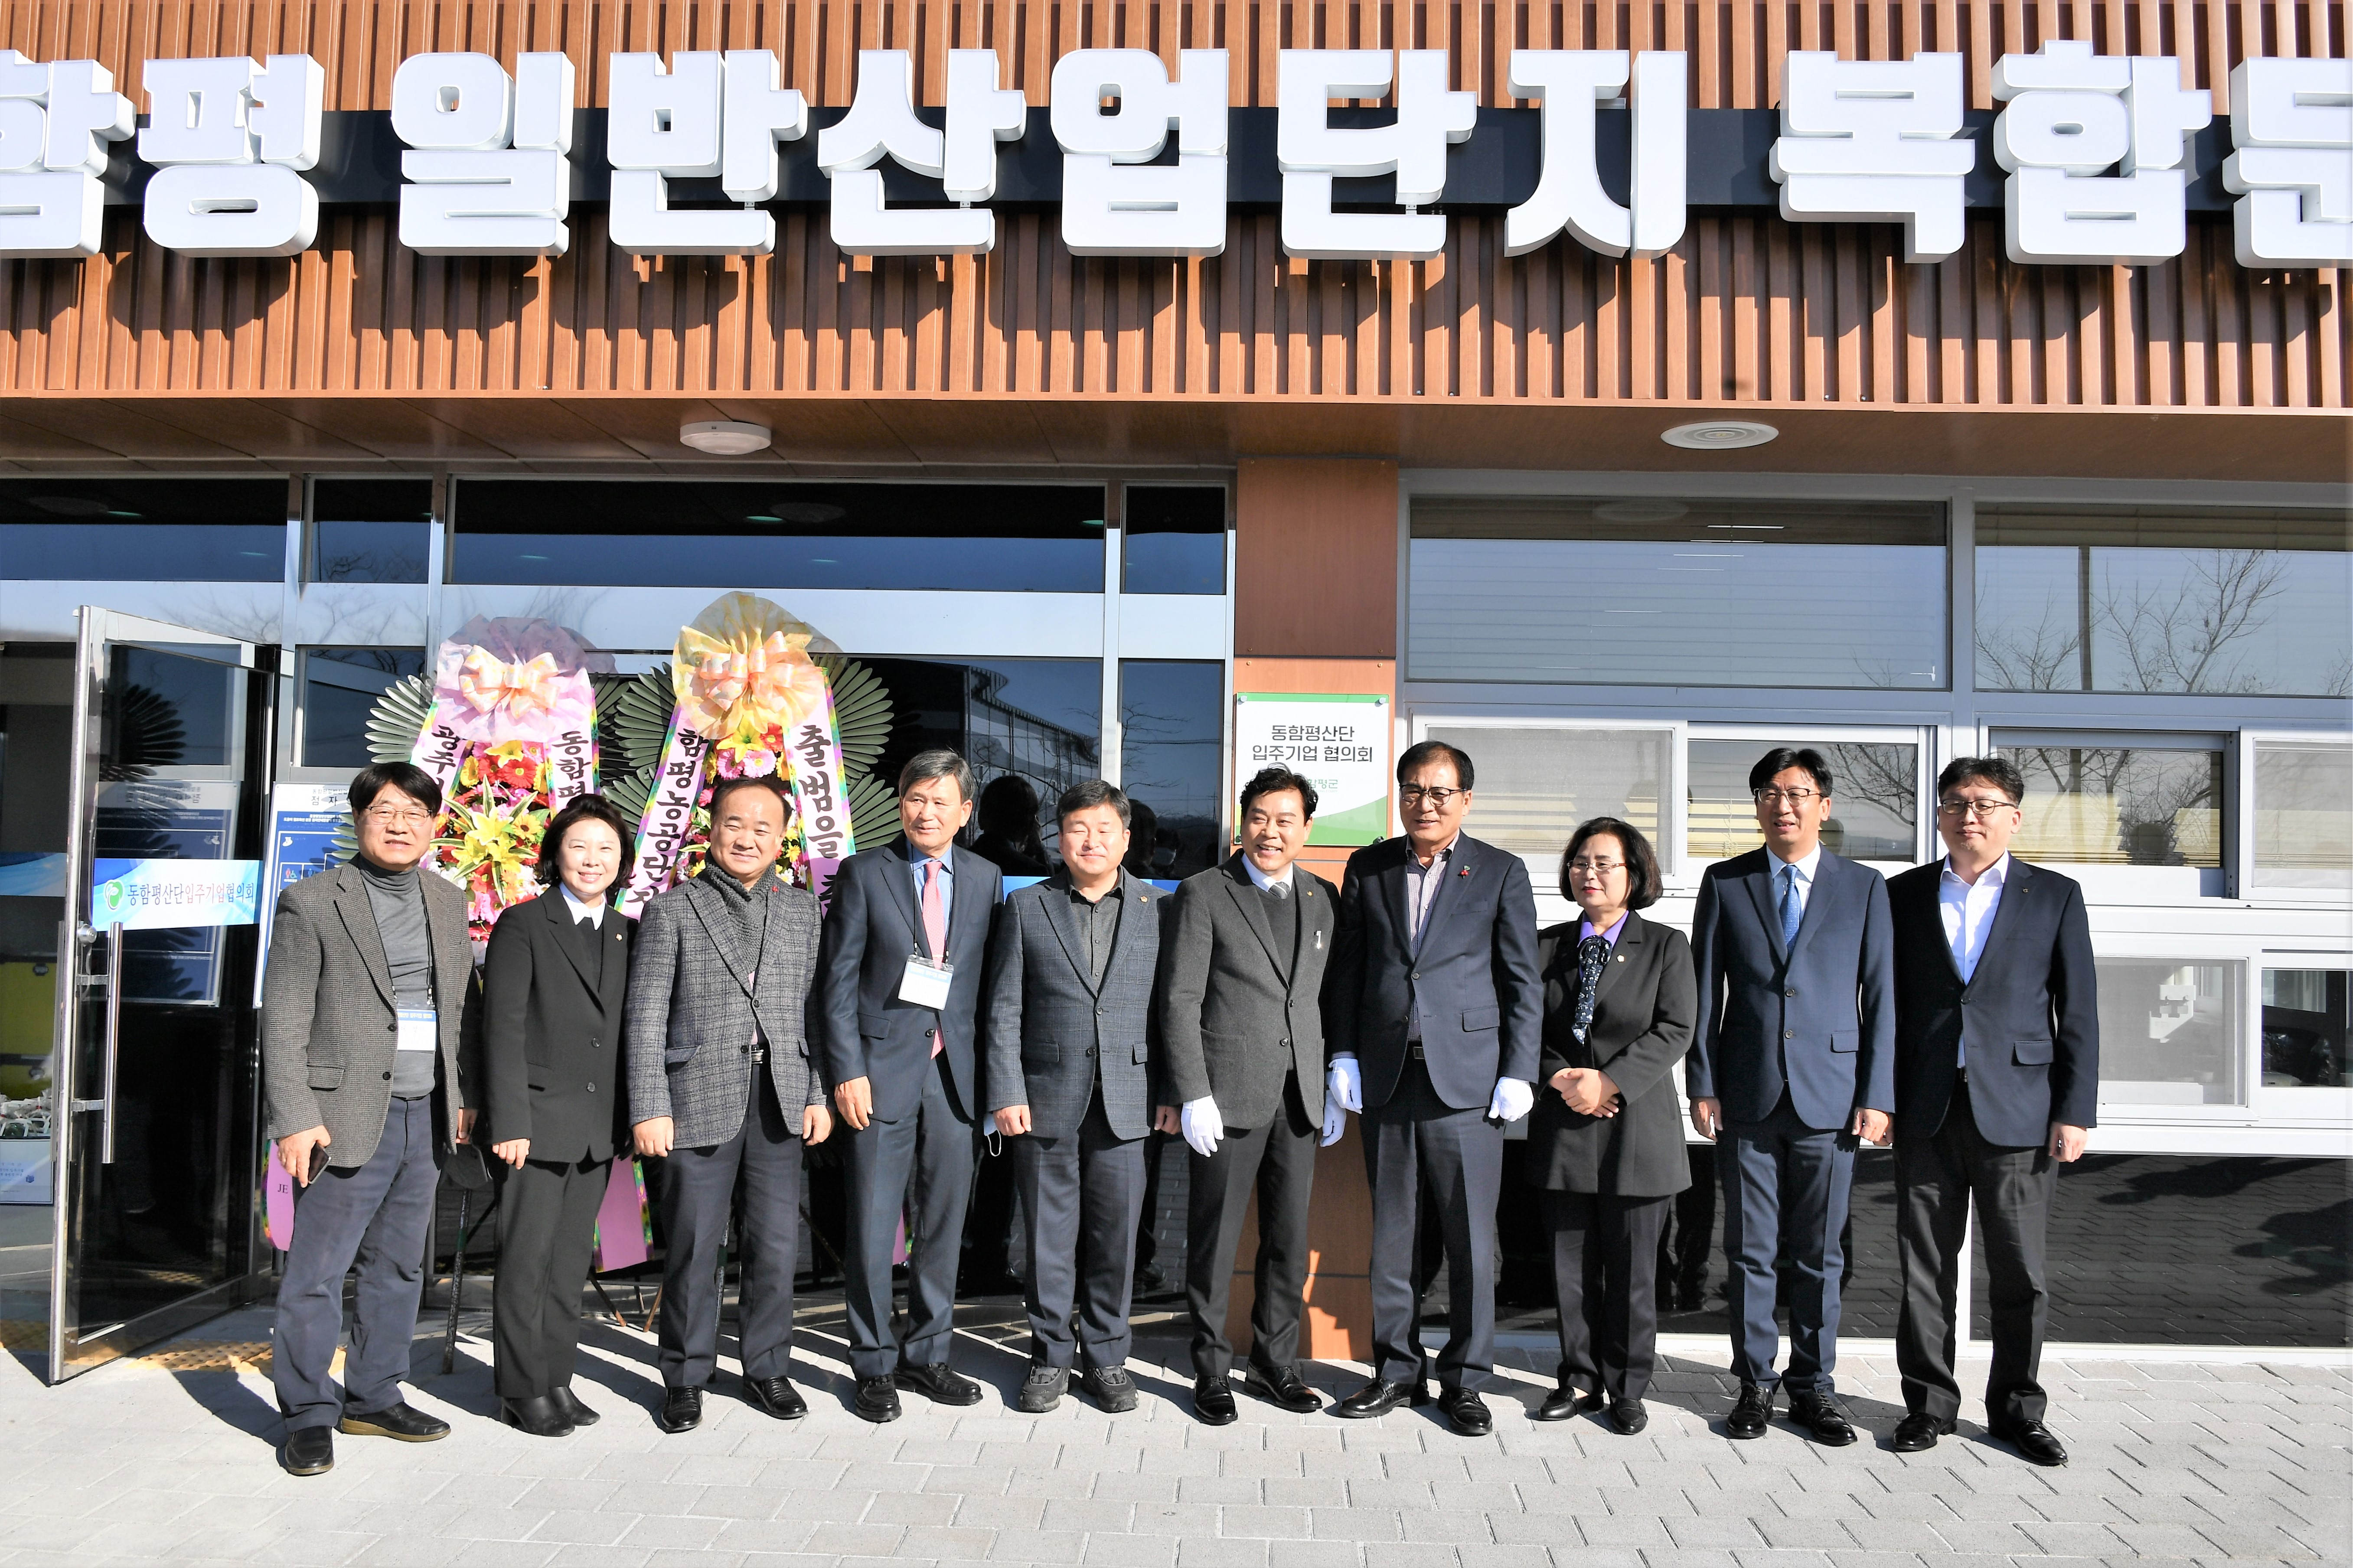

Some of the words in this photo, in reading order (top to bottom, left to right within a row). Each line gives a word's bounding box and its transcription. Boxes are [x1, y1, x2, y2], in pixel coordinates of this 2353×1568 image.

[391, 49, 1687, 260] 일반산업단지
[1271, 725, 1355, 742] 동함평산단
[1253, 745, 1317, 761] 입주기업
[1324, 745, 1372, 762] 협의회
